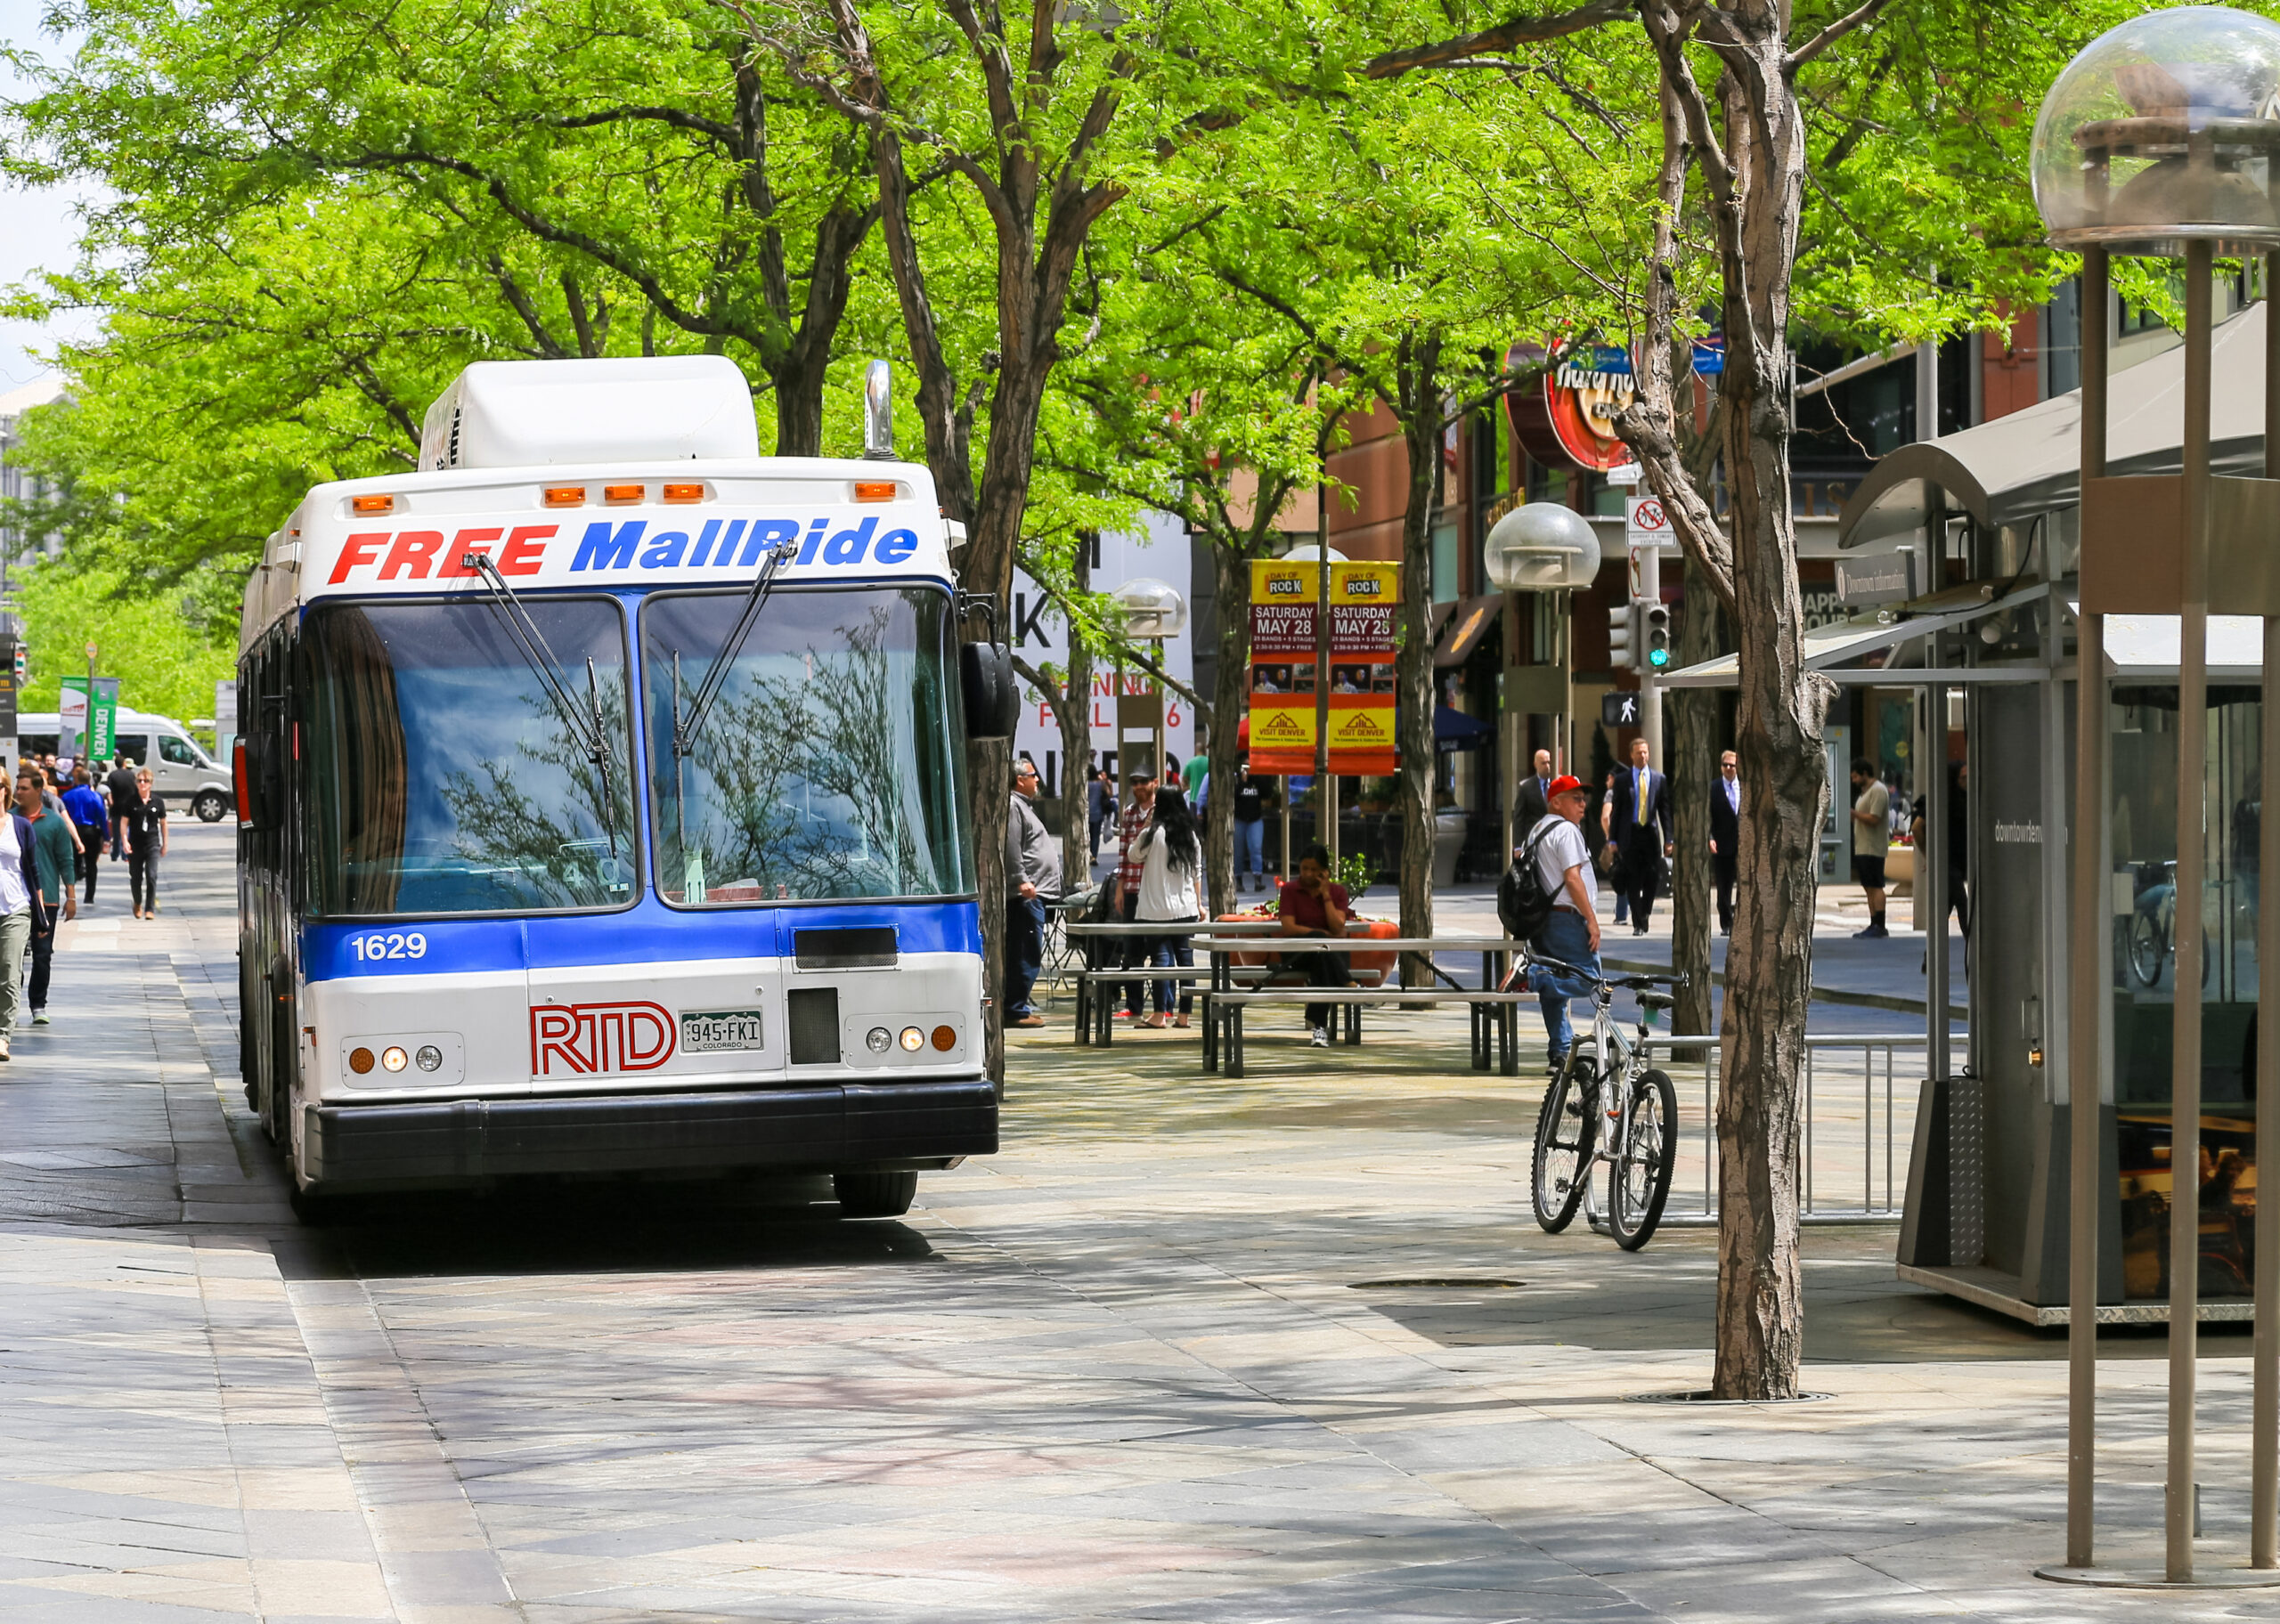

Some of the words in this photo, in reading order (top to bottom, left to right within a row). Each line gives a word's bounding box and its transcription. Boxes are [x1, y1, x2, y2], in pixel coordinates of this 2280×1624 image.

[327, 524, 560, 585] FREE
[568, 516, 918, 572] MallRide
[1348, 572, 1364, 581] DAY
[1365, 572, 1375, 580] OF
[1270, 581, 1302, 593] ROCK
[1348, 581, 1380, 594] ROCK
[1256, 606, 1314, 619] SATURDAY
[1333, 607, 1391, 619] SATURDAY
[1258, 620, 1291, 635] MAY
[1294, 620, 1312, 635] 28
[1336, 620, 1369, 635] MAY
[94, 708, 110, 756] DENVER
[351, 932, 428, 962] 1629
[530, 1001, 677, 1075] RTD
